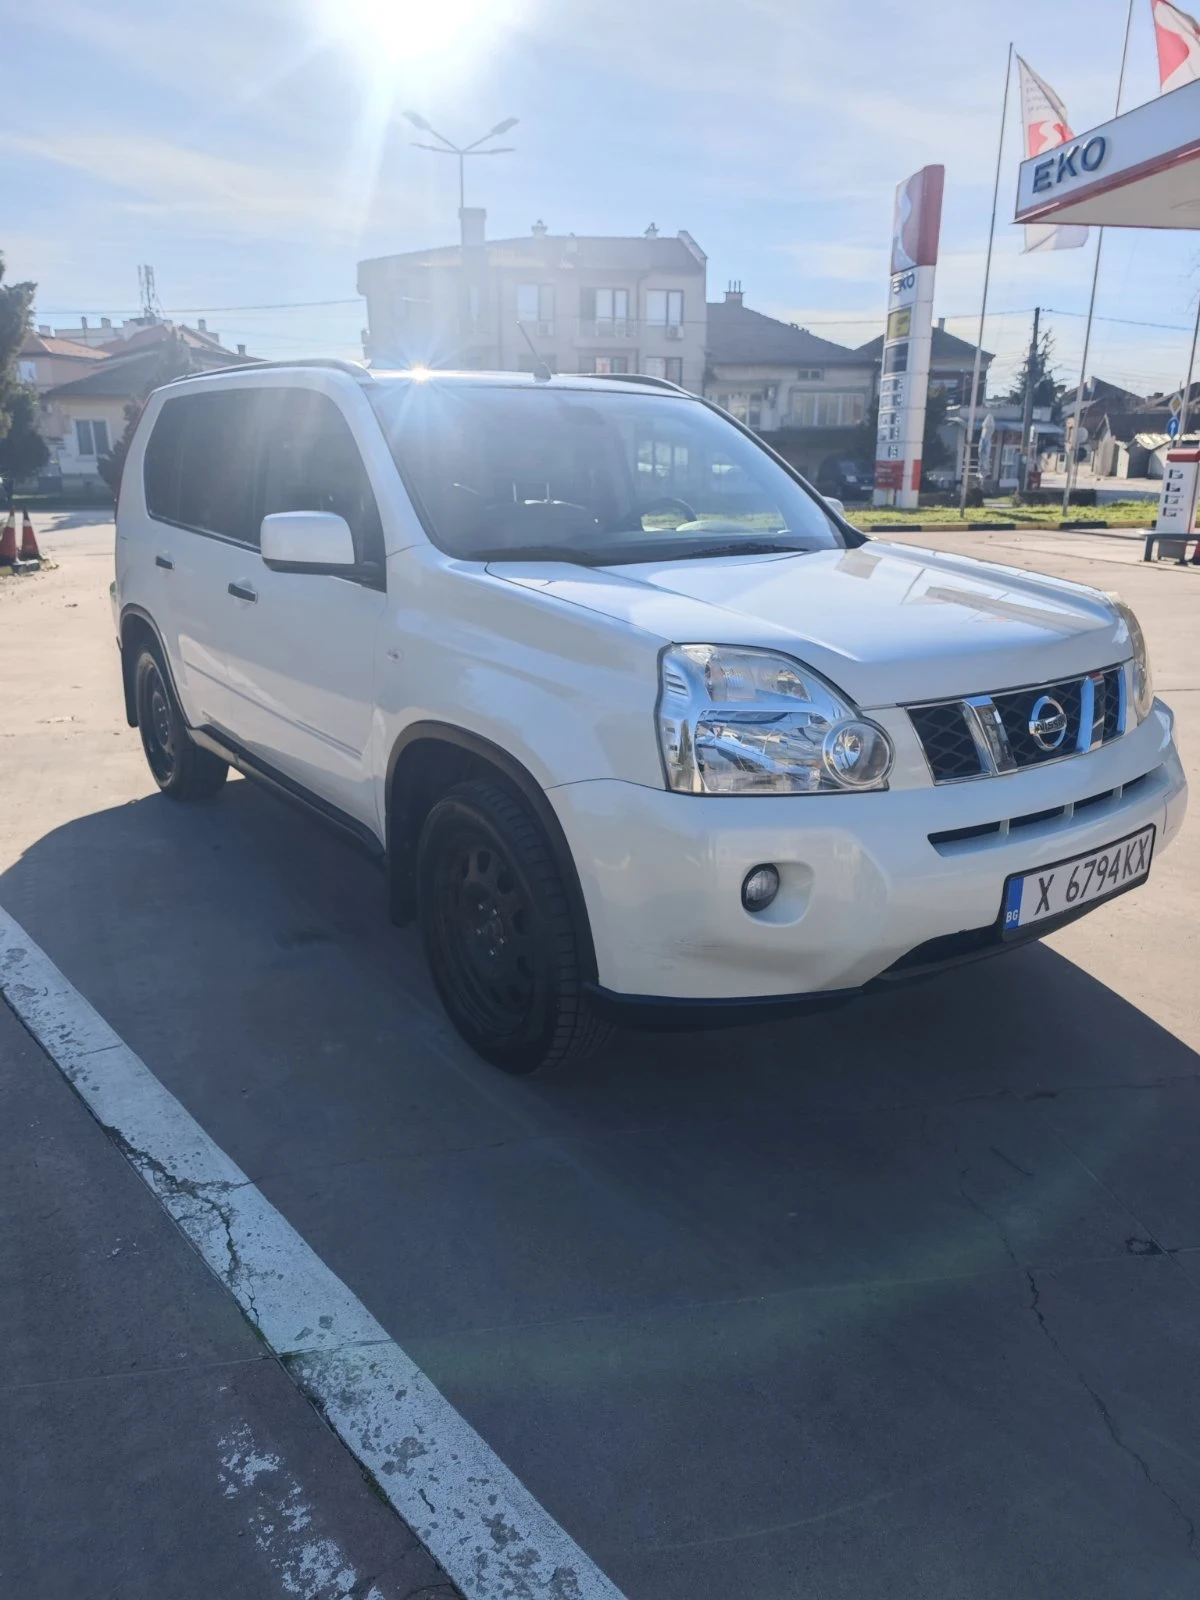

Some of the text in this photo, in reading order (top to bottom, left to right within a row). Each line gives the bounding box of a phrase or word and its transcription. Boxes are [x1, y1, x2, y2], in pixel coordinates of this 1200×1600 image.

[1032, 136, 1106, 194] EKO
[893, 272, 915, 294] EKO
[1035, 716, 1065, 732] NISS
[1034, 834, 1149, 915] X 6794KX
[1005, 909, 1019, 923] BG
